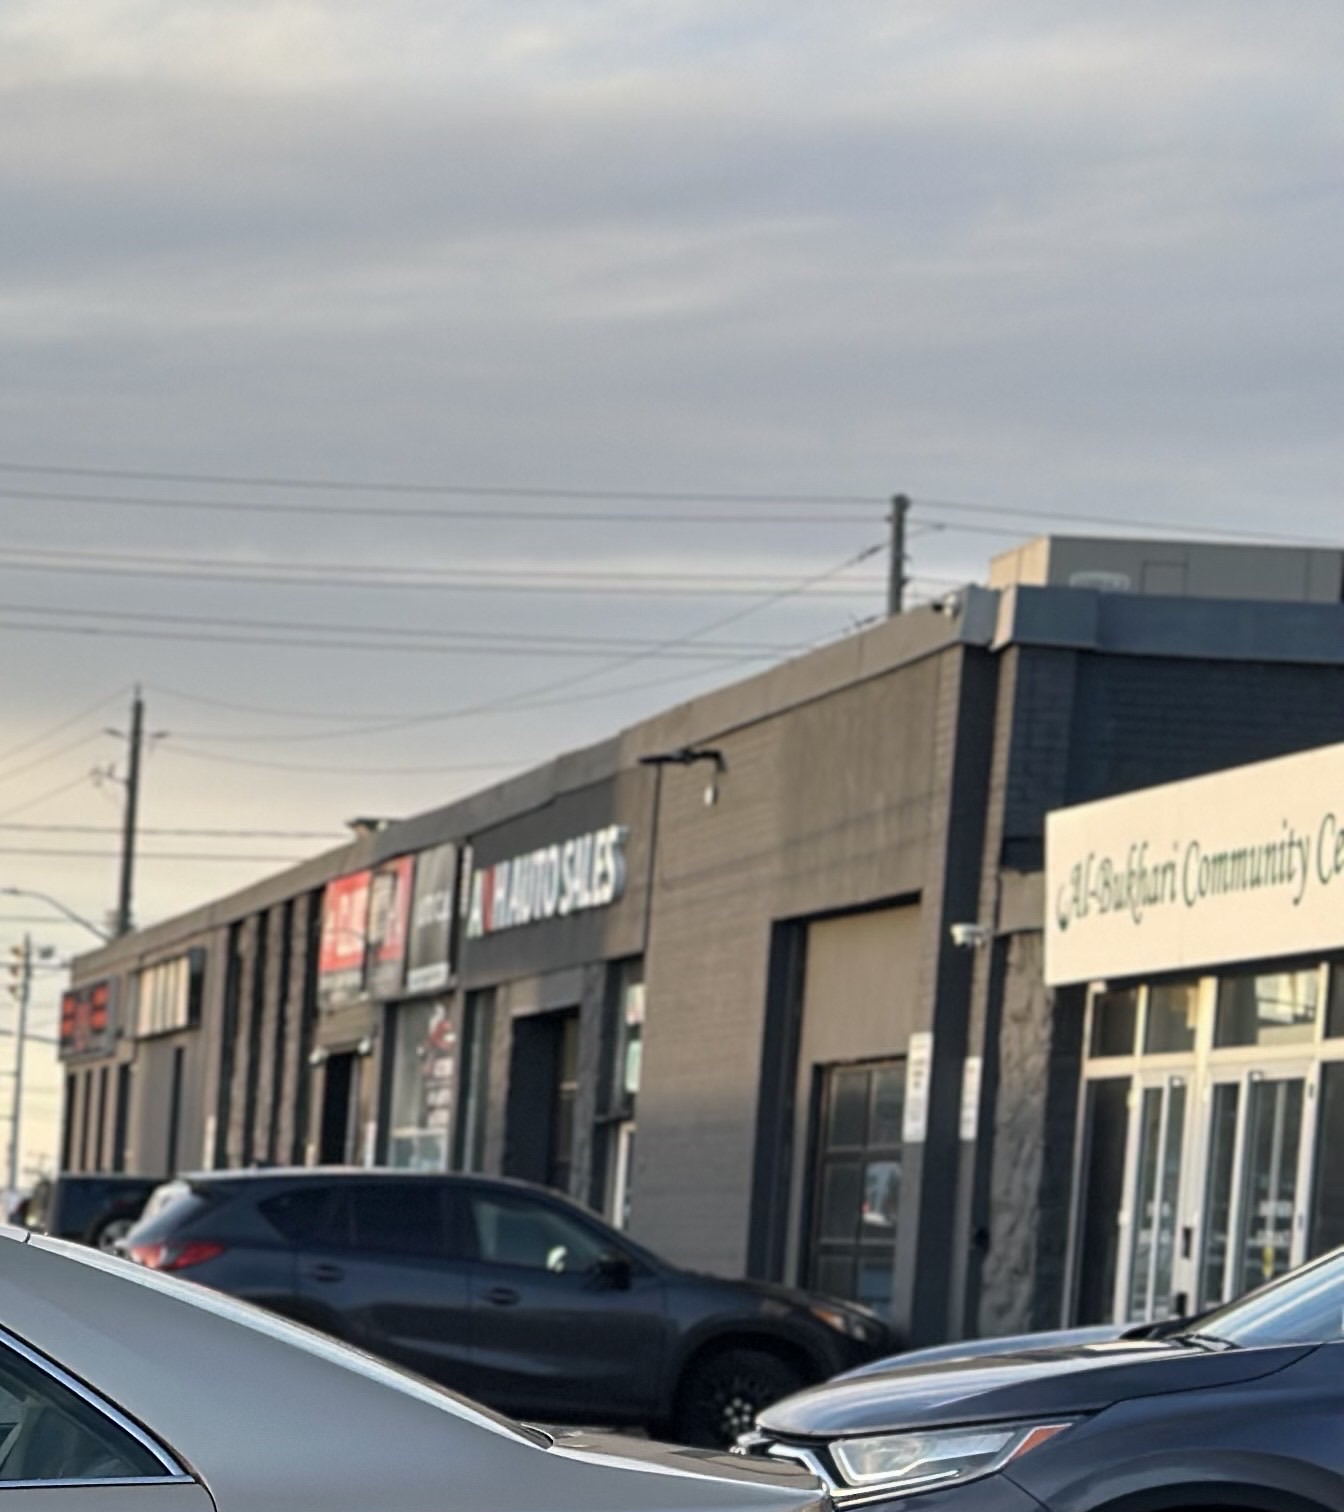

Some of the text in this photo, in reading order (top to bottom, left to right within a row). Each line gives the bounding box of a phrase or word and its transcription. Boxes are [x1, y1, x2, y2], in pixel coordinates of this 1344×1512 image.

[508, 844, 561, 926] AUTO
[558, 823, 623, 917] SALES
[1056, 840, 1178, 933] Al-Bukhari
[1182, 818, 1311, 907] Community
